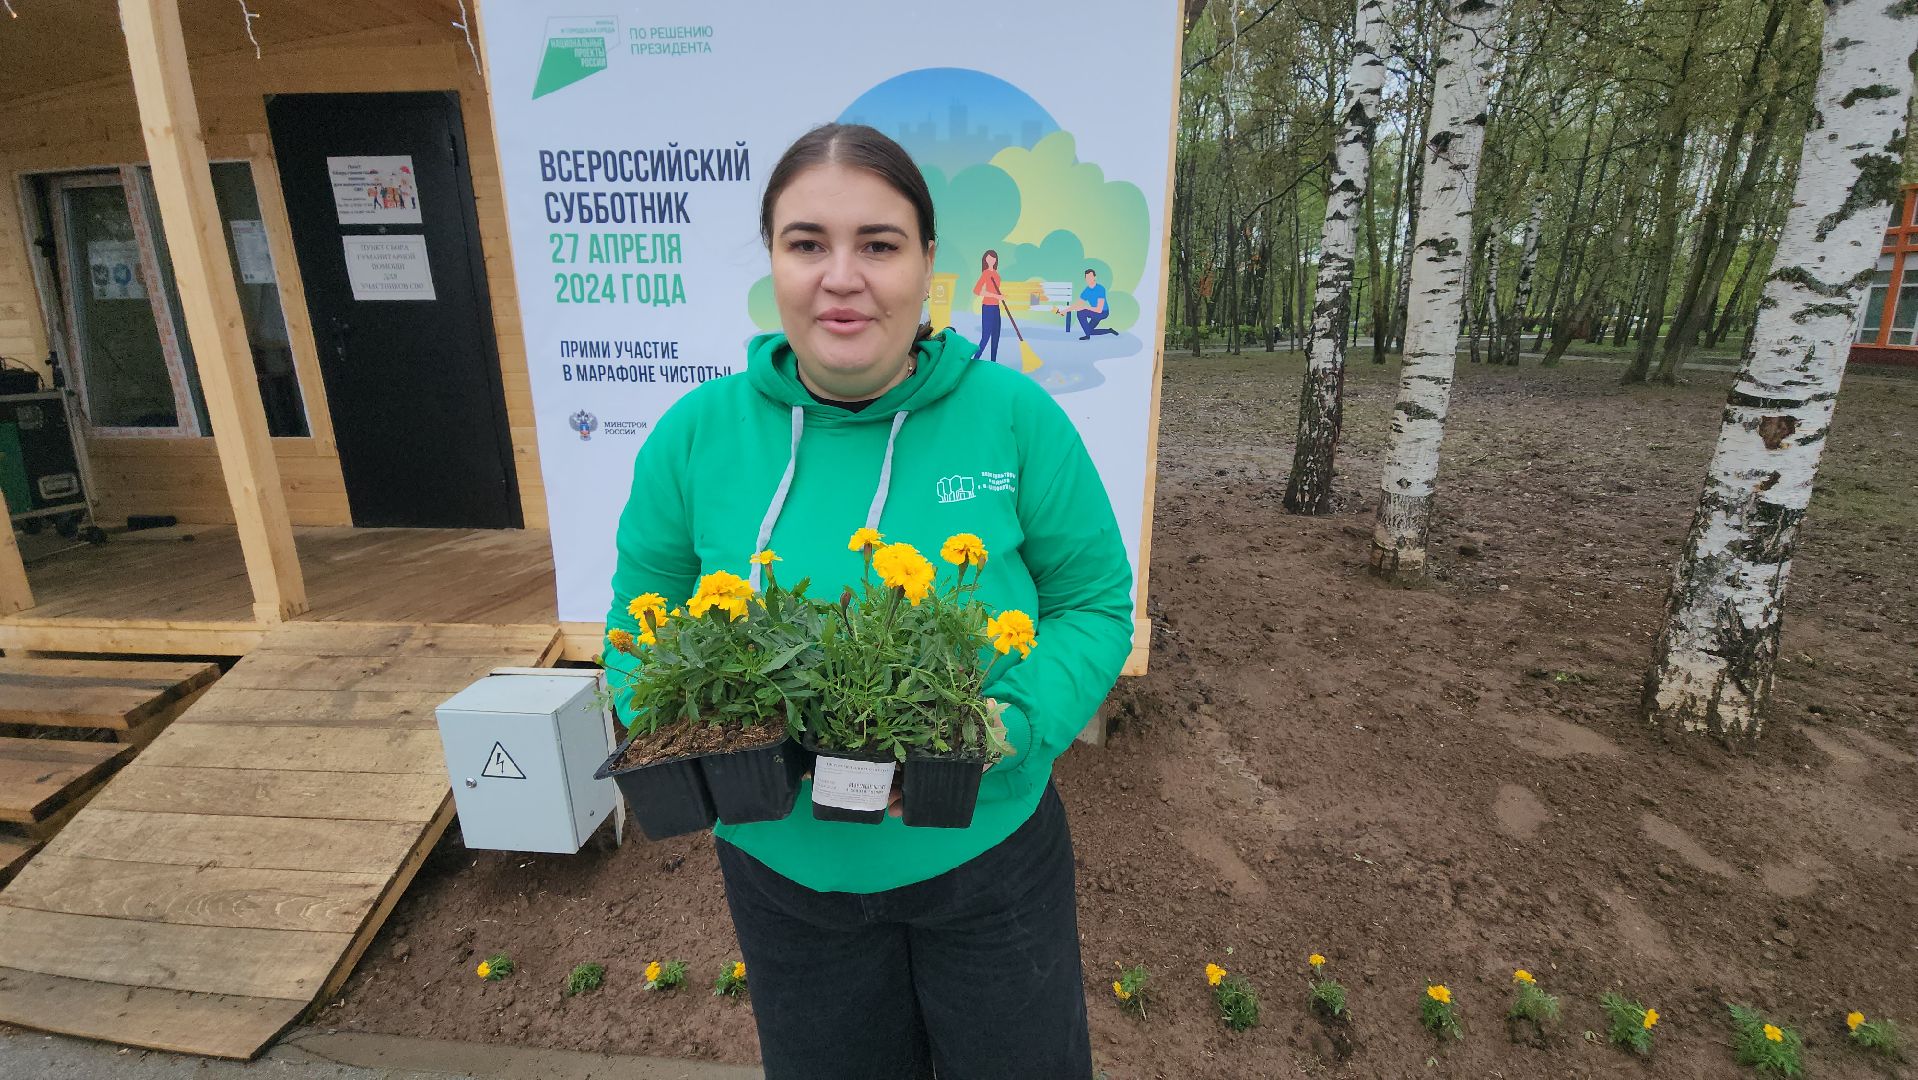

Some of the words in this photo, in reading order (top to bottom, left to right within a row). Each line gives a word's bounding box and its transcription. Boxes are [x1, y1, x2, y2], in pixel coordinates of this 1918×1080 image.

[629, 27, 647, 40] ПО
[650, 25, 713, 39] РЕШЕНИЮ
[631, 42, 712, 56] ПРЕЗИДЕНТА
[539, 141, 751, 183] ВСЕРОССИЙСКИЙ
[544, 191, 691, 224] СУББОТНИК
[550, 233, 579, 264] 27
[588, 233, 682, 264] АПРЕЛЯ
[554, 272, 616, 304] 2024
[621, 273, 687, 307] ГОДА
[560, 340, 611, 359] ПРИМИ
[614, 341, 679, 359] УЧАСТИЕ
[563, 364, 573, 382] В
[576, 364, 656, 383] МАРАФОНЕ
